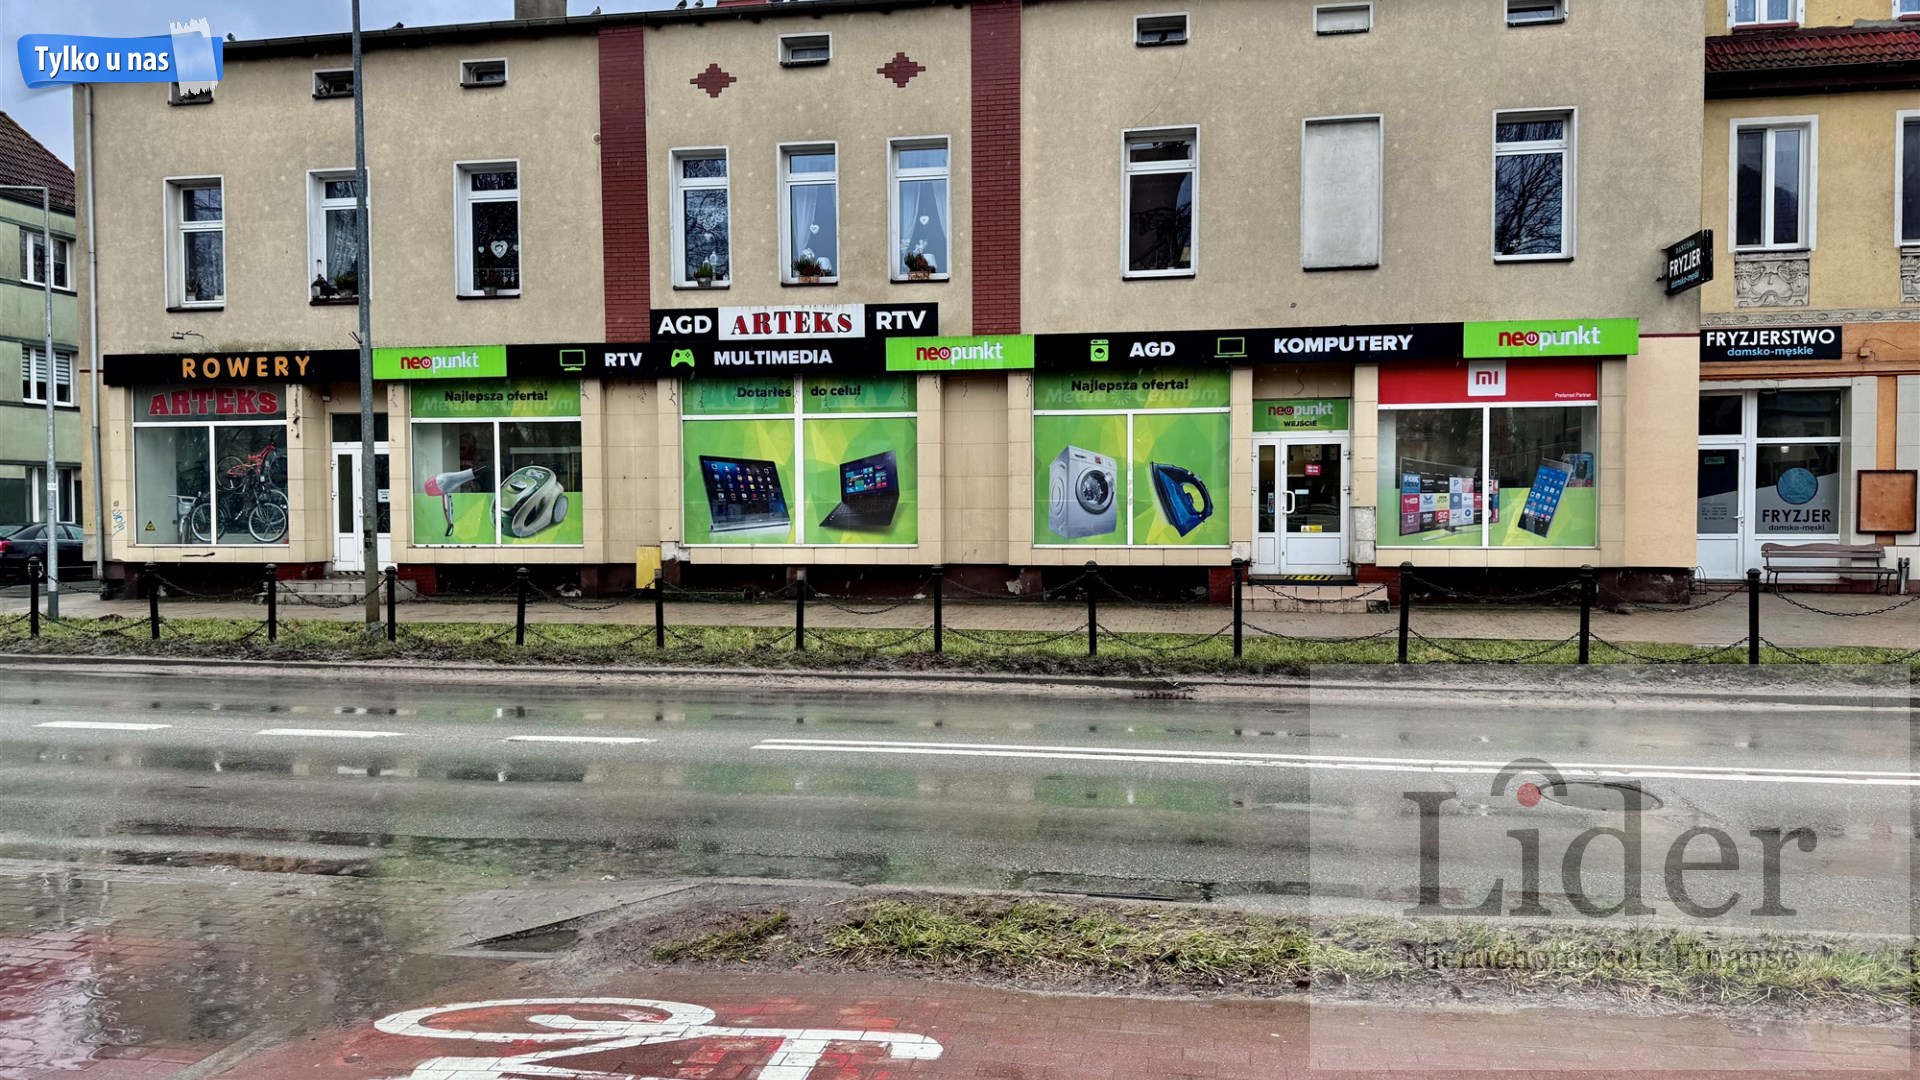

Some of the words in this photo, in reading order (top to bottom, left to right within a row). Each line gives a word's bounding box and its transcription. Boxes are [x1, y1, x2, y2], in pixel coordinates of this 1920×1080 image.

[1669, 247, 1701, 278] FRYZJER
[657, 315, 713, 335] AGD
[730, 310, 853, 336] ARTEKS
[875, 310, 926, 330] RTV
[1273, 334, 1414, 354] KOMPUTERY
[1498, 325, 1601, 352] neopunkt
[1706, 329, 1835, 347] FRYZJERSTWO
[713, 349, 834, 366] MULTIMEDIA
[916, 341, 1004, 365] neopunkt
[1129, 341, 1176, 358] AGD
[1727, 346, 1814, 357] damsko-męskie
[182, 355, 311, 379] ROWERY
[400, 351, 480, 373] neopunkt
[604, 352, 643, 367] RTV
[810, 387, 827, 397] do
[830, 385, 861, 396] celu!
[1071, 380, 1138, 393] Najlepsza
[1142, 378, 1189, 391] oferta!
[148, 387, 279, 416] ARTEKS
[444, 391, 504, 403] Najlepsza
[507, 391, 548, 401] oferta!
[1283, 418, 1317, 427] WEJŚCIE
[1762, 509, 1831, 523] FRYZJER
